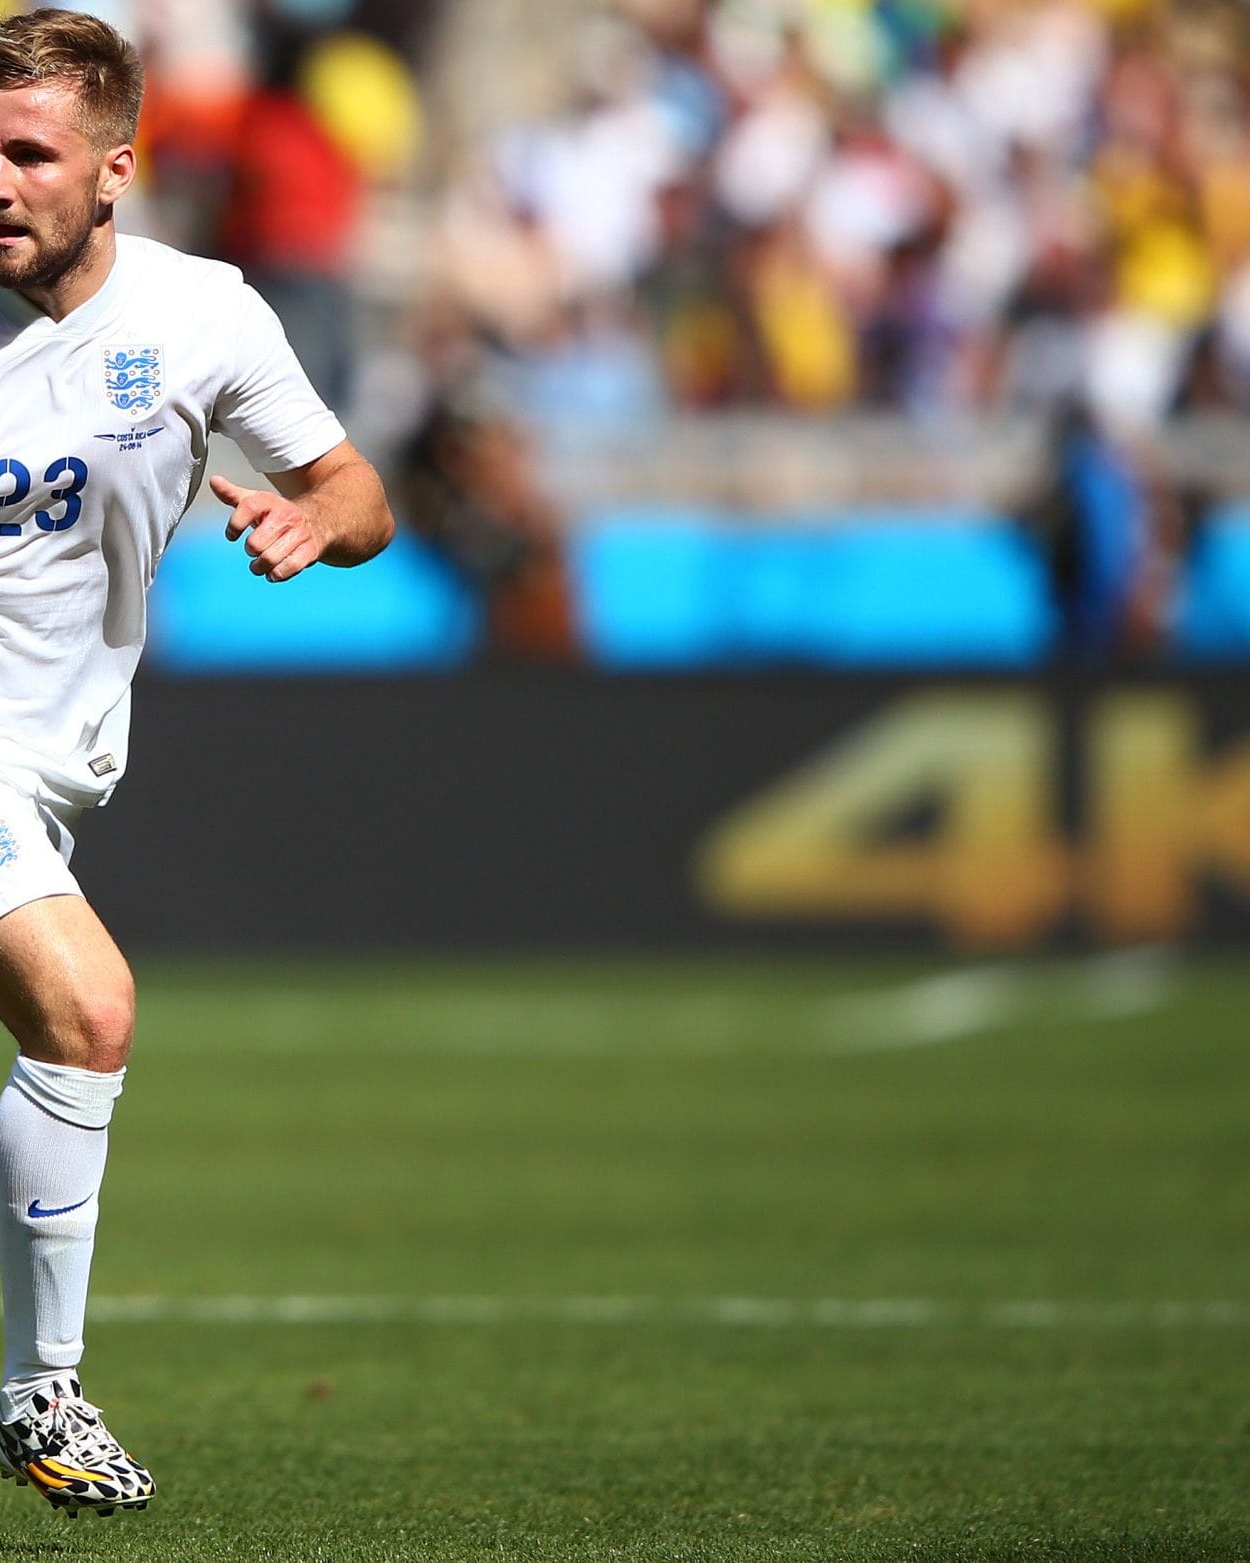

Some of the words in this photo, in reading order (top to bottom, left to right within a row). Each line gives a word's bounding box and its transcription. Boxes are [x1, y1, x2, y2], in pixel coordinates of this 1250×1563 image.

[117, 433, 134, 442] COSTA
[135, 431, 147, 440] RICA
[692, 690, 1250, 948] 4K
